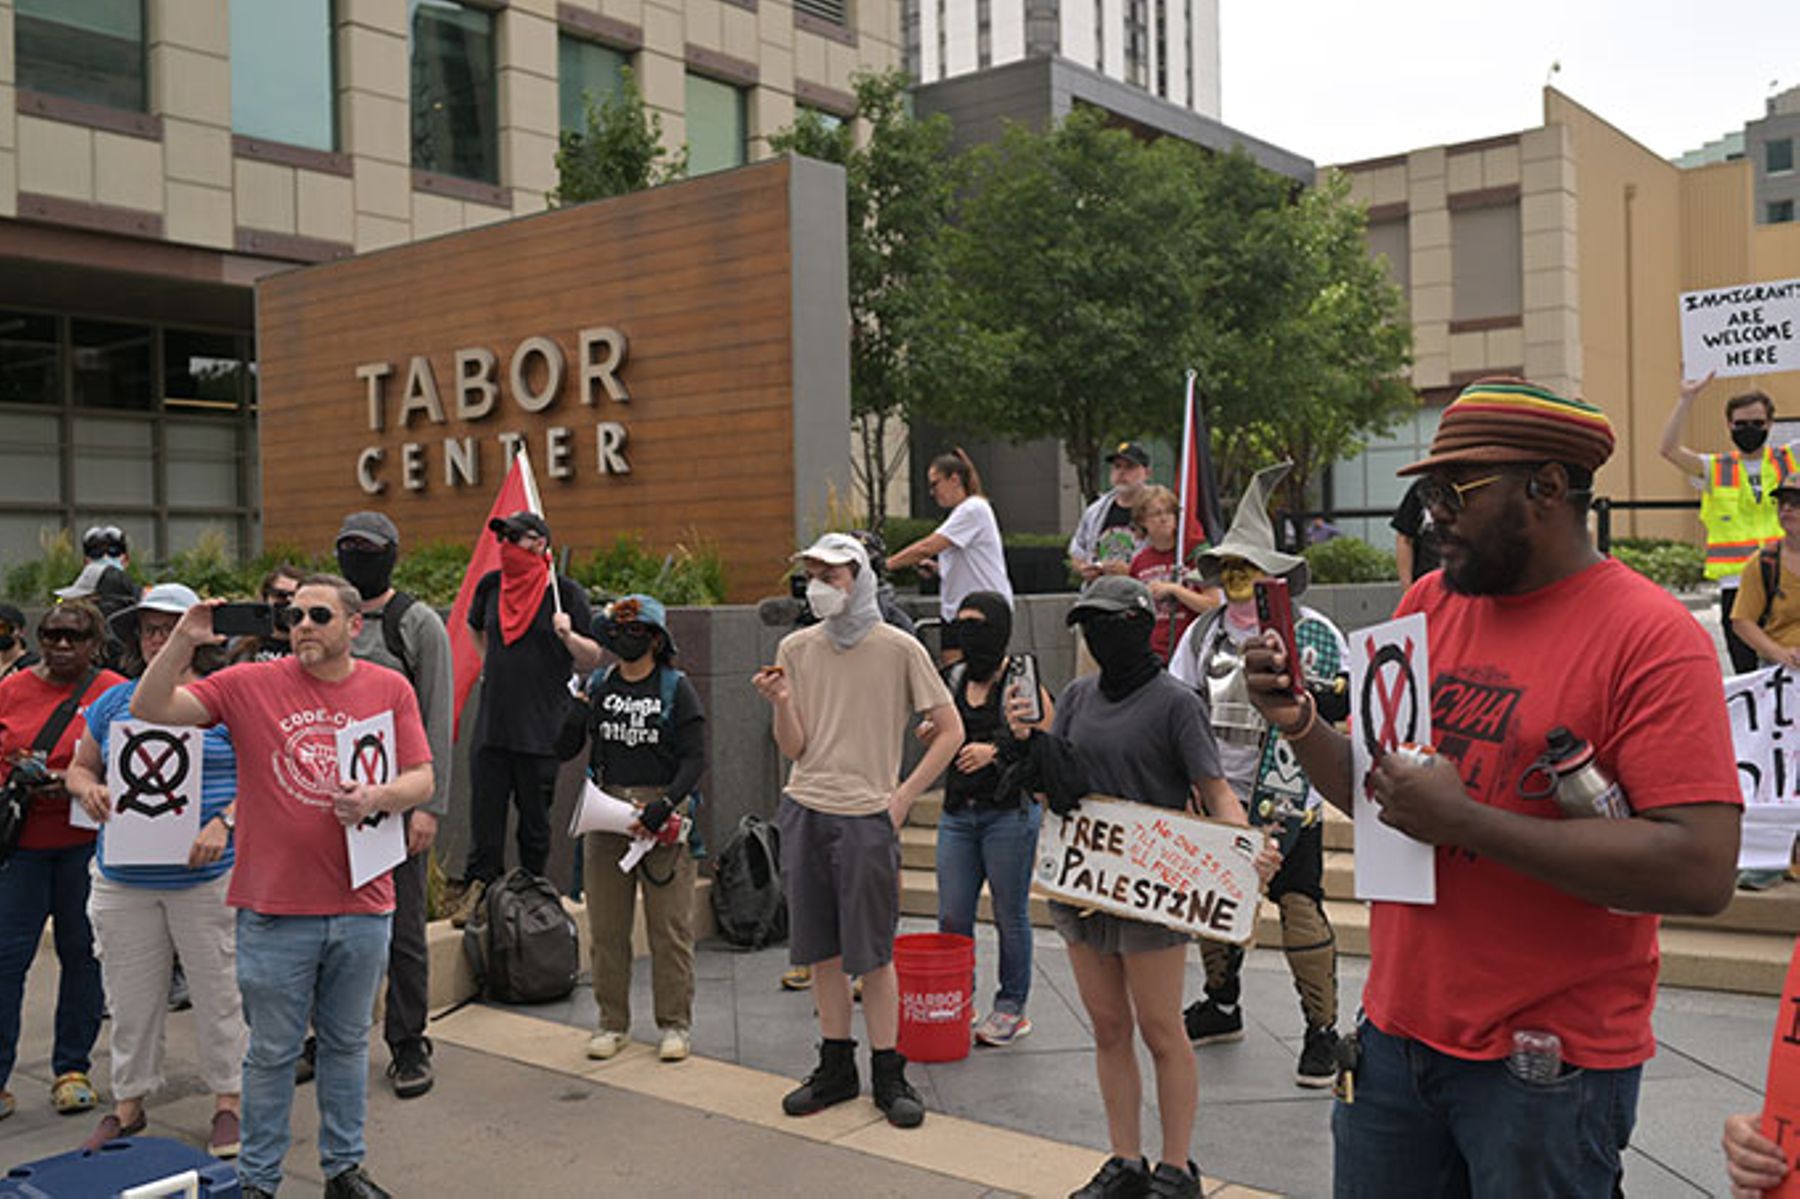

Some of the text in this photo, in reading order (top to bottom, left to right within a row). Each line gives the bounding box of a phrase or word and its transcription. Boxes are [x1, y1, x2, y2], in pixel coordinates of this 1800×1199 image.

[1685, 284, 1800, 311] IMMIGRANT
[1727, 306, 1764, 326] ARE
[1702, 320, 1792, 348] WELCOME
[1726, 345, 1777, 366] HERE
[356, 327, 630, 431] TABOR
[357, 422, 630, 494] CENTER
[1431, 684, 1516, 736] CWA
